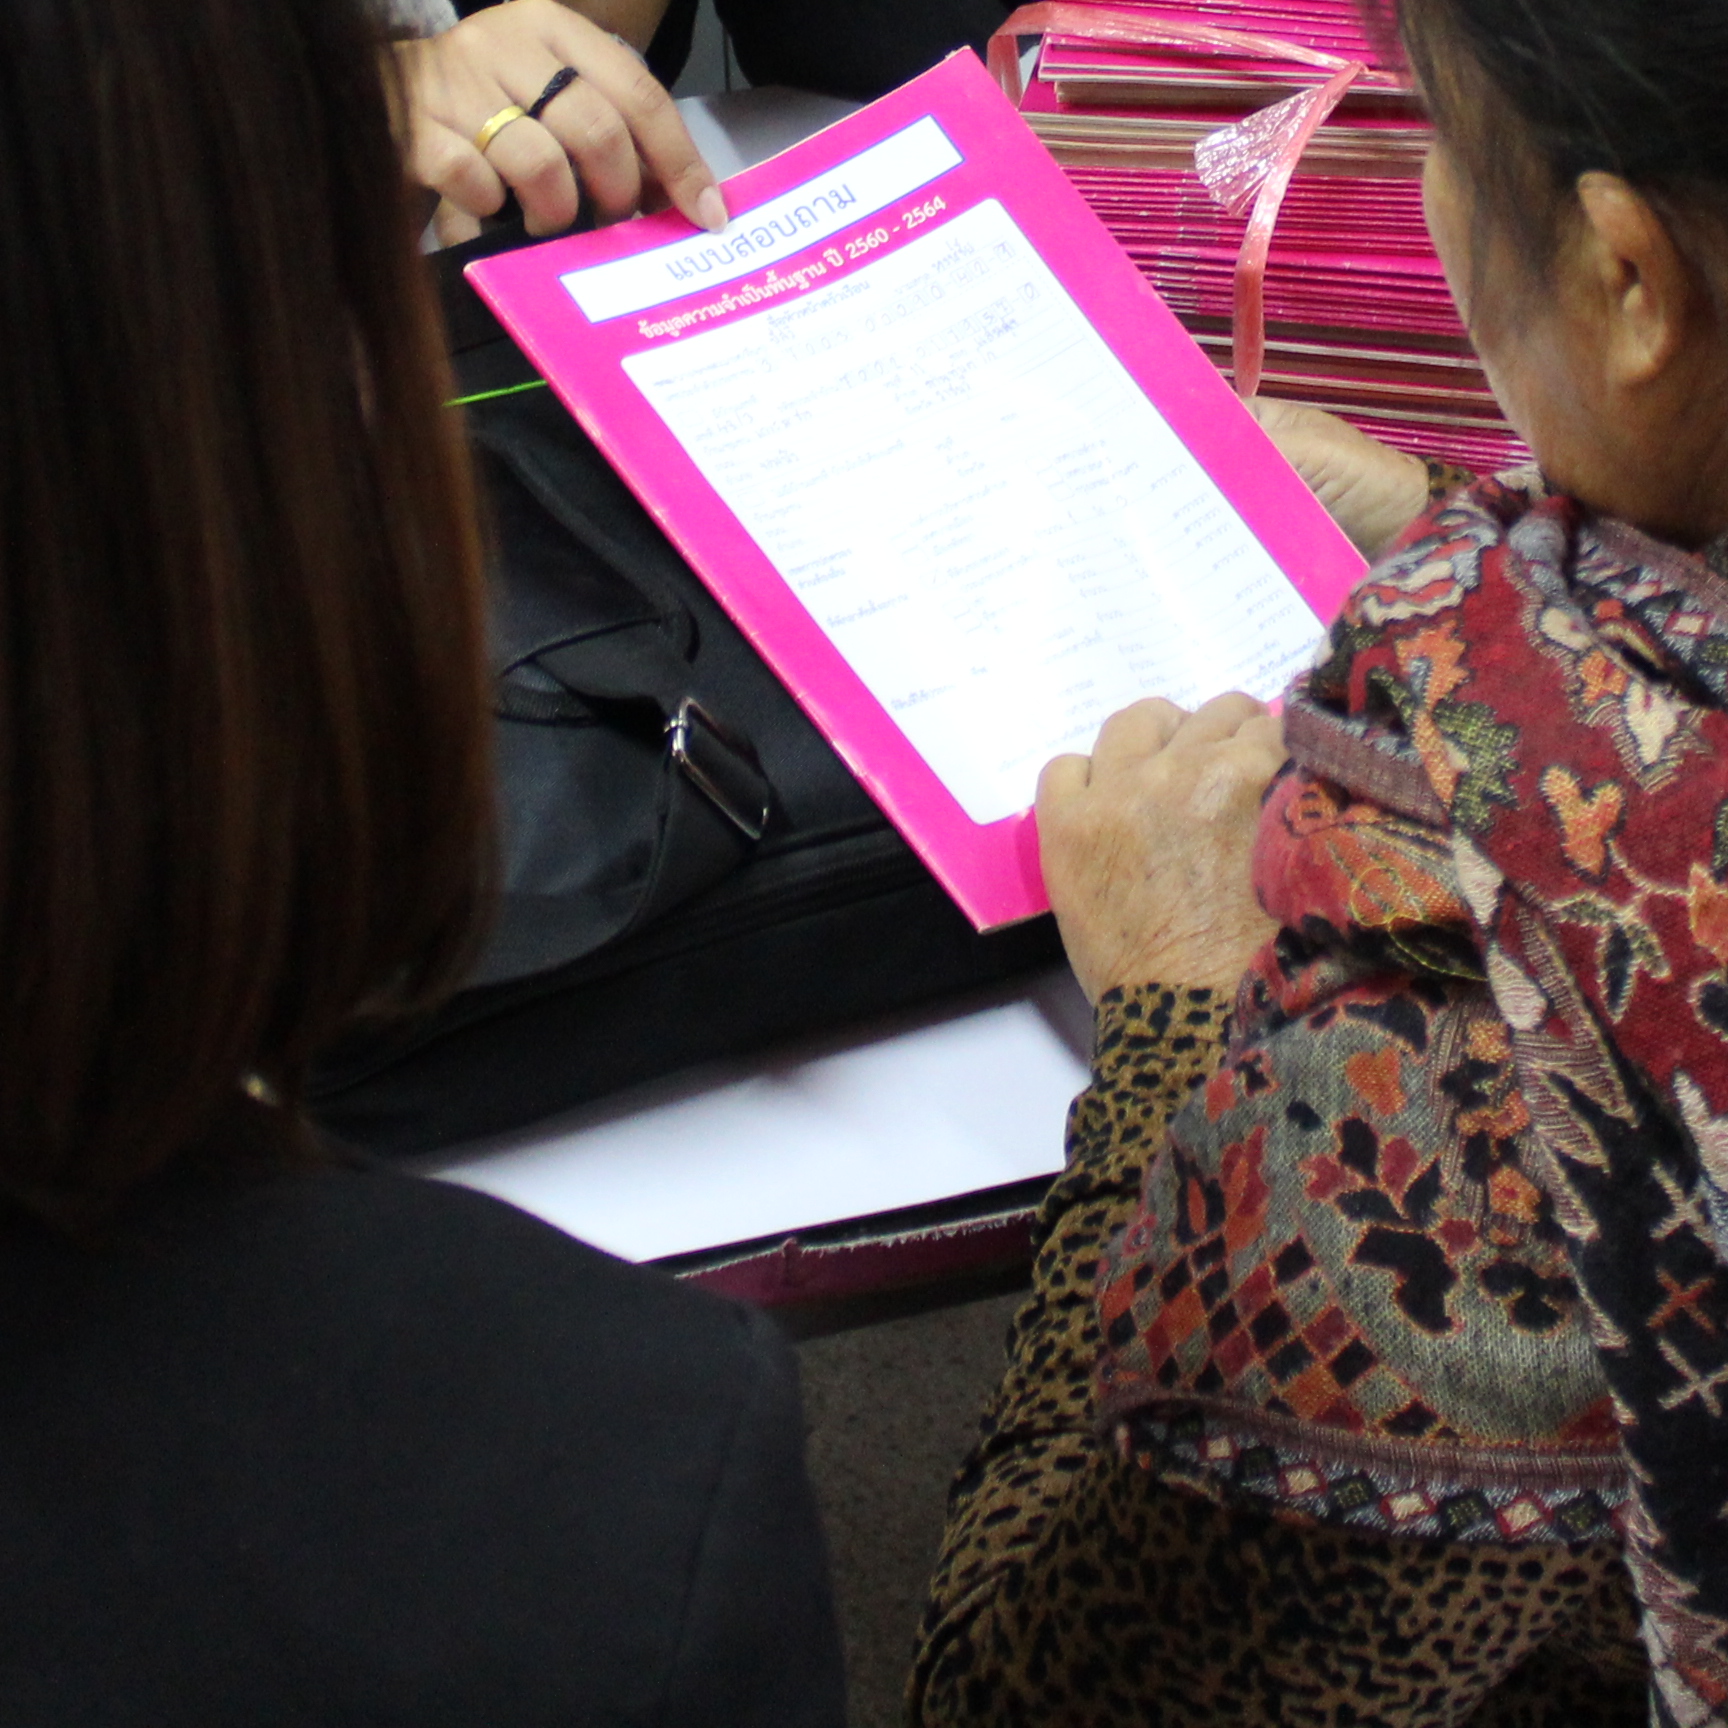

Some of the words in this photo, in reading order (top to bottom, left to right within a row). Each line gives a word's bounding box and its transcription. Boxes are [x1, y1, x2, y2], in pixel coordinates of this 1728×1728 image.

[639, 261, 826, 336] ข้อมูลความจำเป็นพื้นฐาน
[823, 245, 844, 267] ปี
[844, 225, 890, 260] 2560
[901, 194, 947, 229] 2564
[663, 180, 858, 283] แบบสอบถาม
